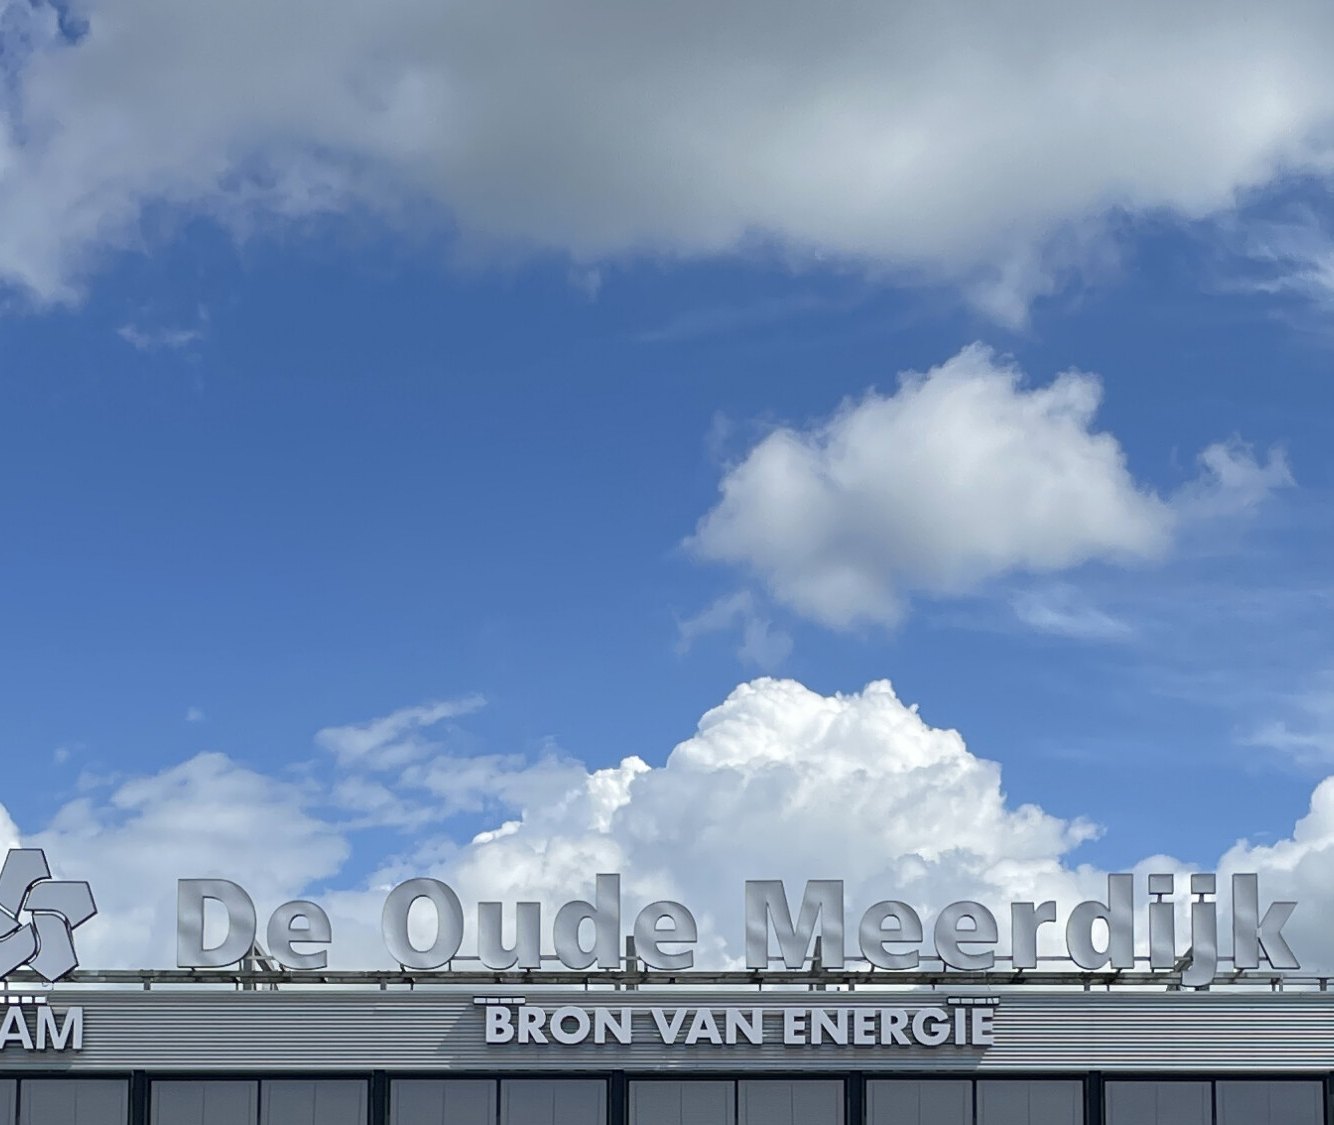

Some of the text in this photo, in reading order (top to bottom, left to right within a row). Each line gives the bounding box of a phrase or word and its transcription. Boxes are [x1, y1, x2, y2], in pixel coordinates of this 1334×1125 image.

[177, 873, 1300, 987] De Oude Meerdijk
[485, 1006, 995, 1046] BRON VAN ENERGIE
